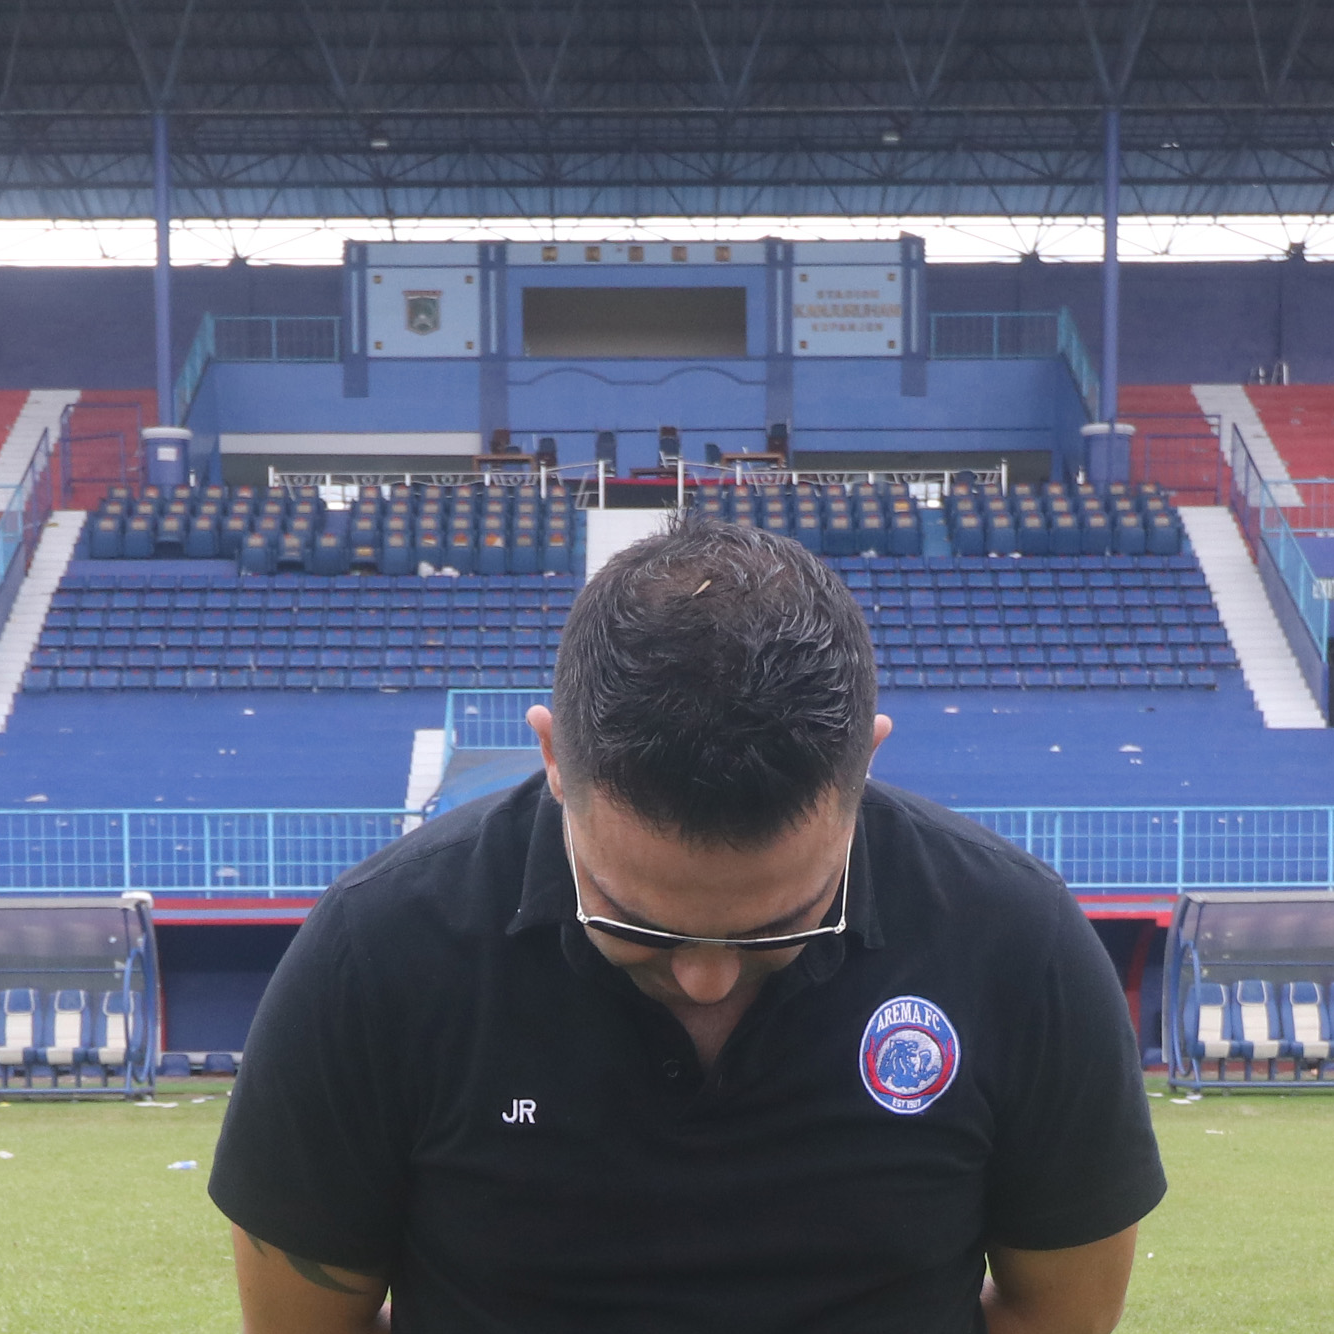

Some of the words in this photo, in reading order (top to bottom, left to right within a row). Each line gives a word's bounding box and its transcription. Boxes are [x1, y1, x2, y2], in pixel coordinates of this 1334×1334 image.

[875, 1002, 923, 1034] AREMA
[923, 1006, 942, 1032] FC
[501, 1098, 537, 1125] JR
[892, 1096, 906, 1108] EST
